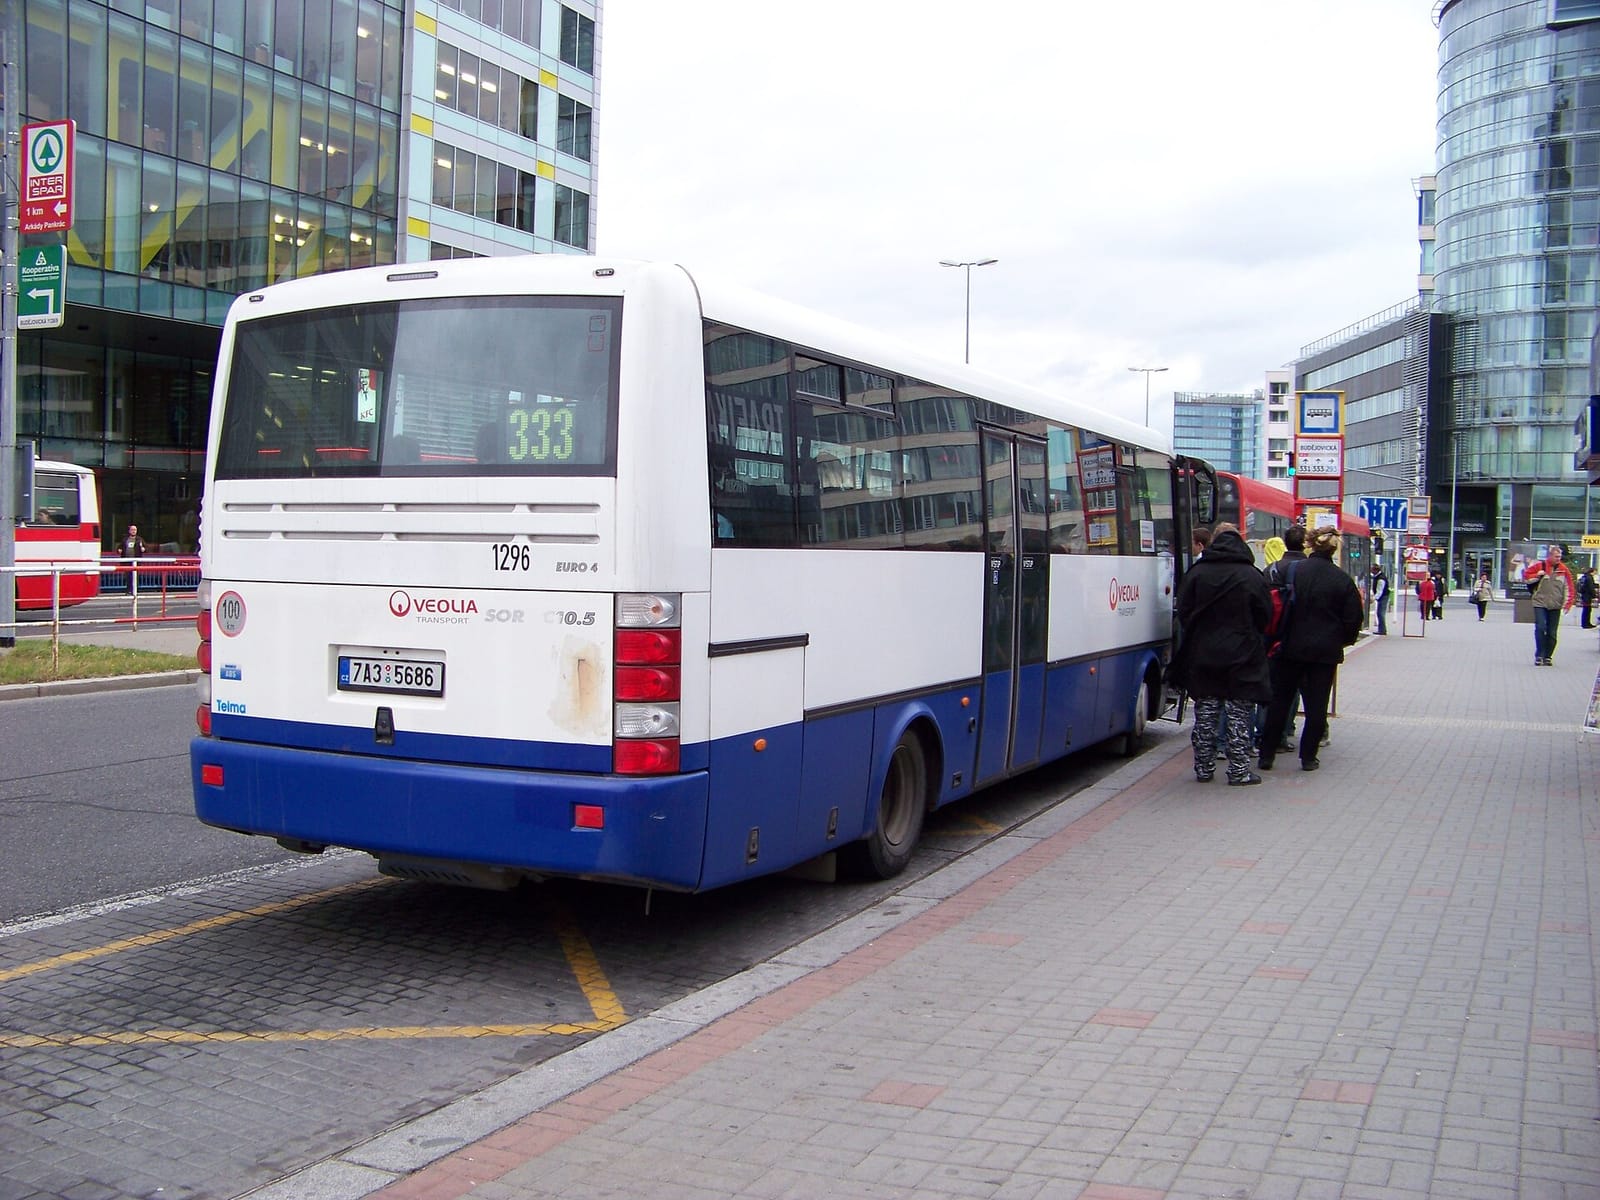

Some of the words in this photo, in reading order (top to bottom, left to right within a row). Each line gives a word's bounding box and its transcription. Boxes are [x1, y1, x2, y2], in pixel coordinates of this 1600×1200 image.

[30, 176, 63, 187] INTER
[32, 185, 63, 196] SPAR
[32, 207, 44, 216] km
[22, 264, 59, 275] Kooperativa
[360, 408, 374, 420] KFC
[509, 408, 573, 460] 333
[492, 543, 530, 571] 1296
[555, 561, 588, 573] EURO
[590, 562, 598, 573] 4
[1118, 585, 1140, 603] VEOLIA
[222, 599, 240, 620] 100
[413, 598, 478, 614] VEOLIA
[416, 616, 469, 625] TRANSPORT
[484, 608, 526, 624] SOR
[341, 674, 349, 682] CZ
[353, 662, 381, 683] 7A3
[394, 664, 434, 687] 5686
[216, 699, 246, 714] Telma
